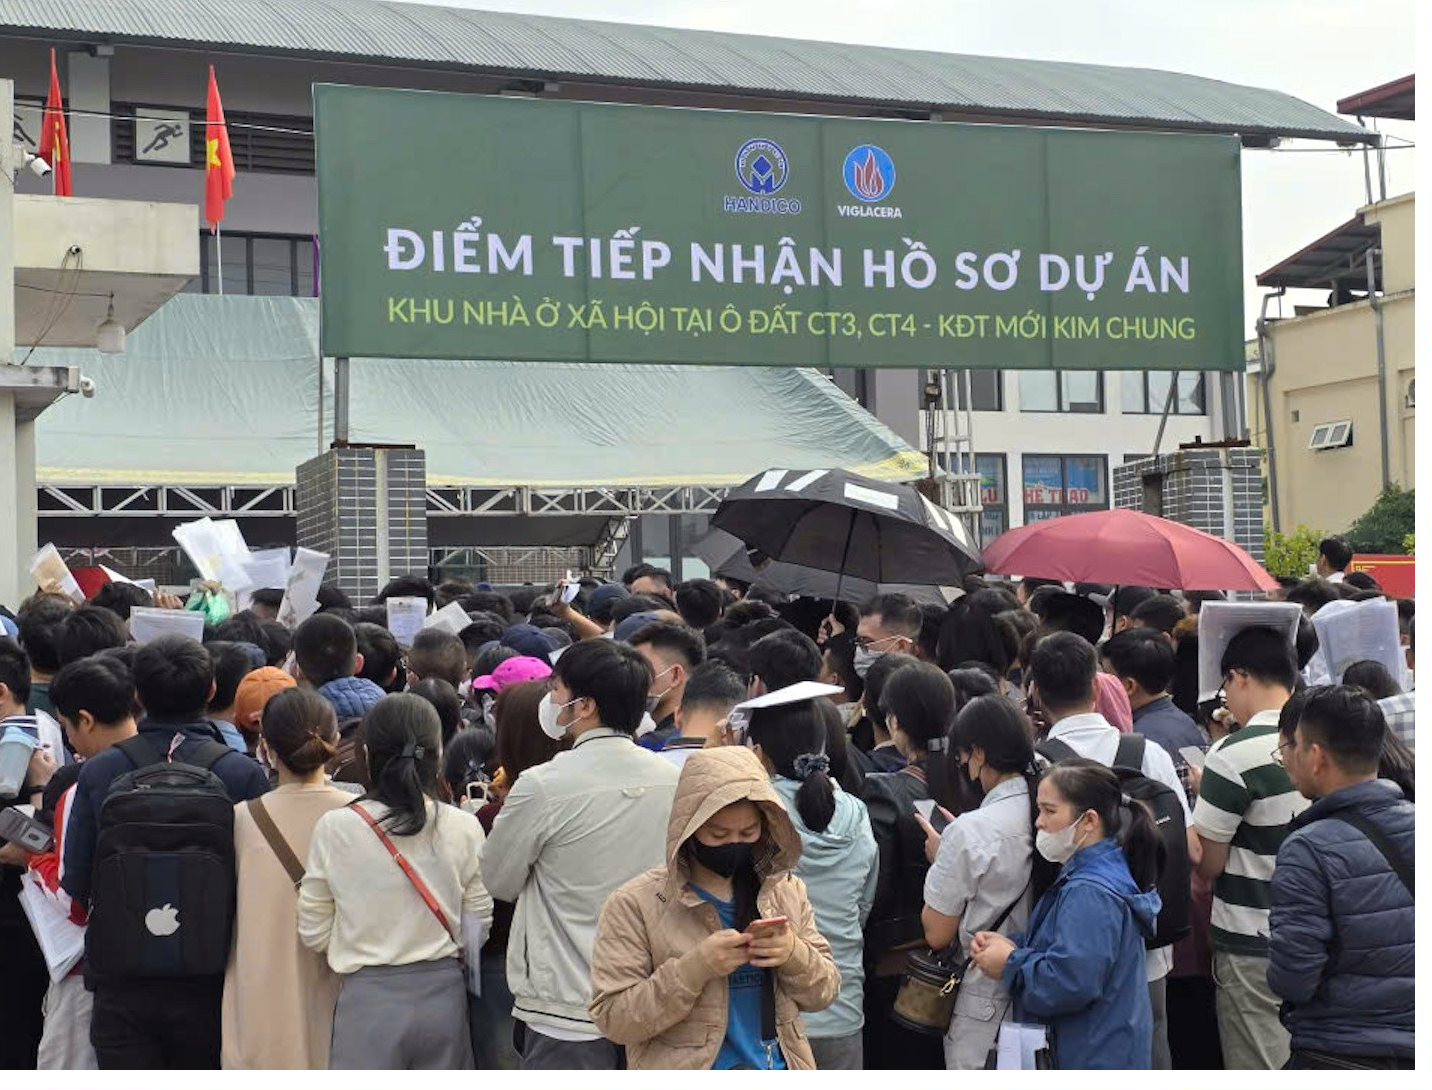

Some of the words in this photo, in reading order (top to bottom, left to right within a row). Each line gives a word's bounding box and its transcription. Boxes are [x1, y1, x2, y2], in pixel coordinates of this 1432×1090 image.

[724, 195, 801, 215] HANDICO
[837, 205, 902, 219] VIGLACERA
[384, 216, 533, 276] ĐIỂM
[552, 226, 671, 280] TIẾP
[690, 236, 842, 294] NHẬN
[863, 237, 937, 289] HỒ
[954, 249, 1021, 291] SƠ
[1039, 251, 1114, 301] DỰ
[1124, 246, 1189, 293] ÁN
[388, 297, 454, 324] KHU
[463, 295, 530, 327] NHÀ
[535, 297, 560, 327] Ở
[567, 300, 608, 329] XÃ
[614, 301, 664, 336] HỘI
[671, 306, 712, 337] TẠI
[719, 304, 742, 333] Ô
[748, 302, 803, 335] ĐẤT
[807, 311, 862, 339] CT3,
[868, 313, 917, 337] CT4
[938, 314, 990, 338] KĐT
[996, 309, 1046, 339] MỚI
[1054, 316, 1099, 339] KIM
[1106, 316, 1195, 340] CHUNG
